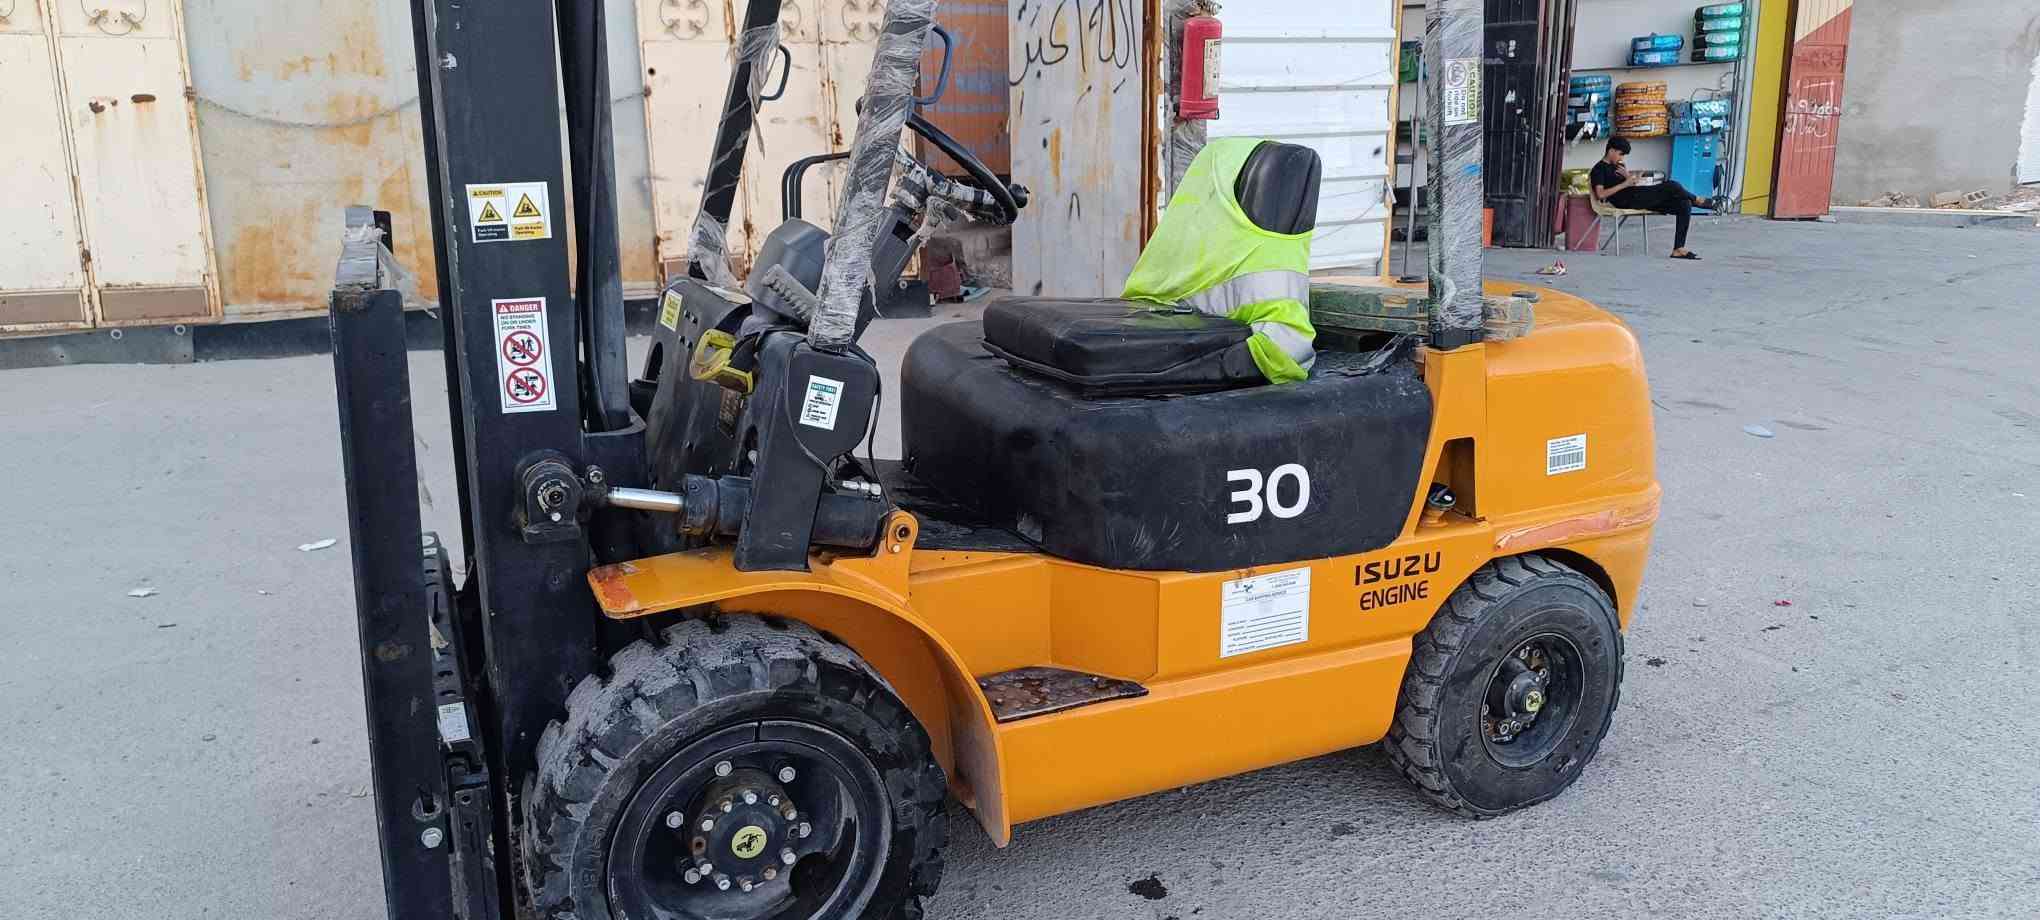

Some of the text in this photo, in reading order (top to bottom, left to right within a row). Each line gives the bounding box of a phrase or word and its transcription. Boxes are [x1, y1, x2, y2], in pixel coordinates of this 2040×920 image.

[510, 304, 538, 312] DANGER
[1227, 463, 1311, 524] 30
[1354, 551, 1441, 586] ISUZU
[1359, 580, 1429, 611] ENGINE
